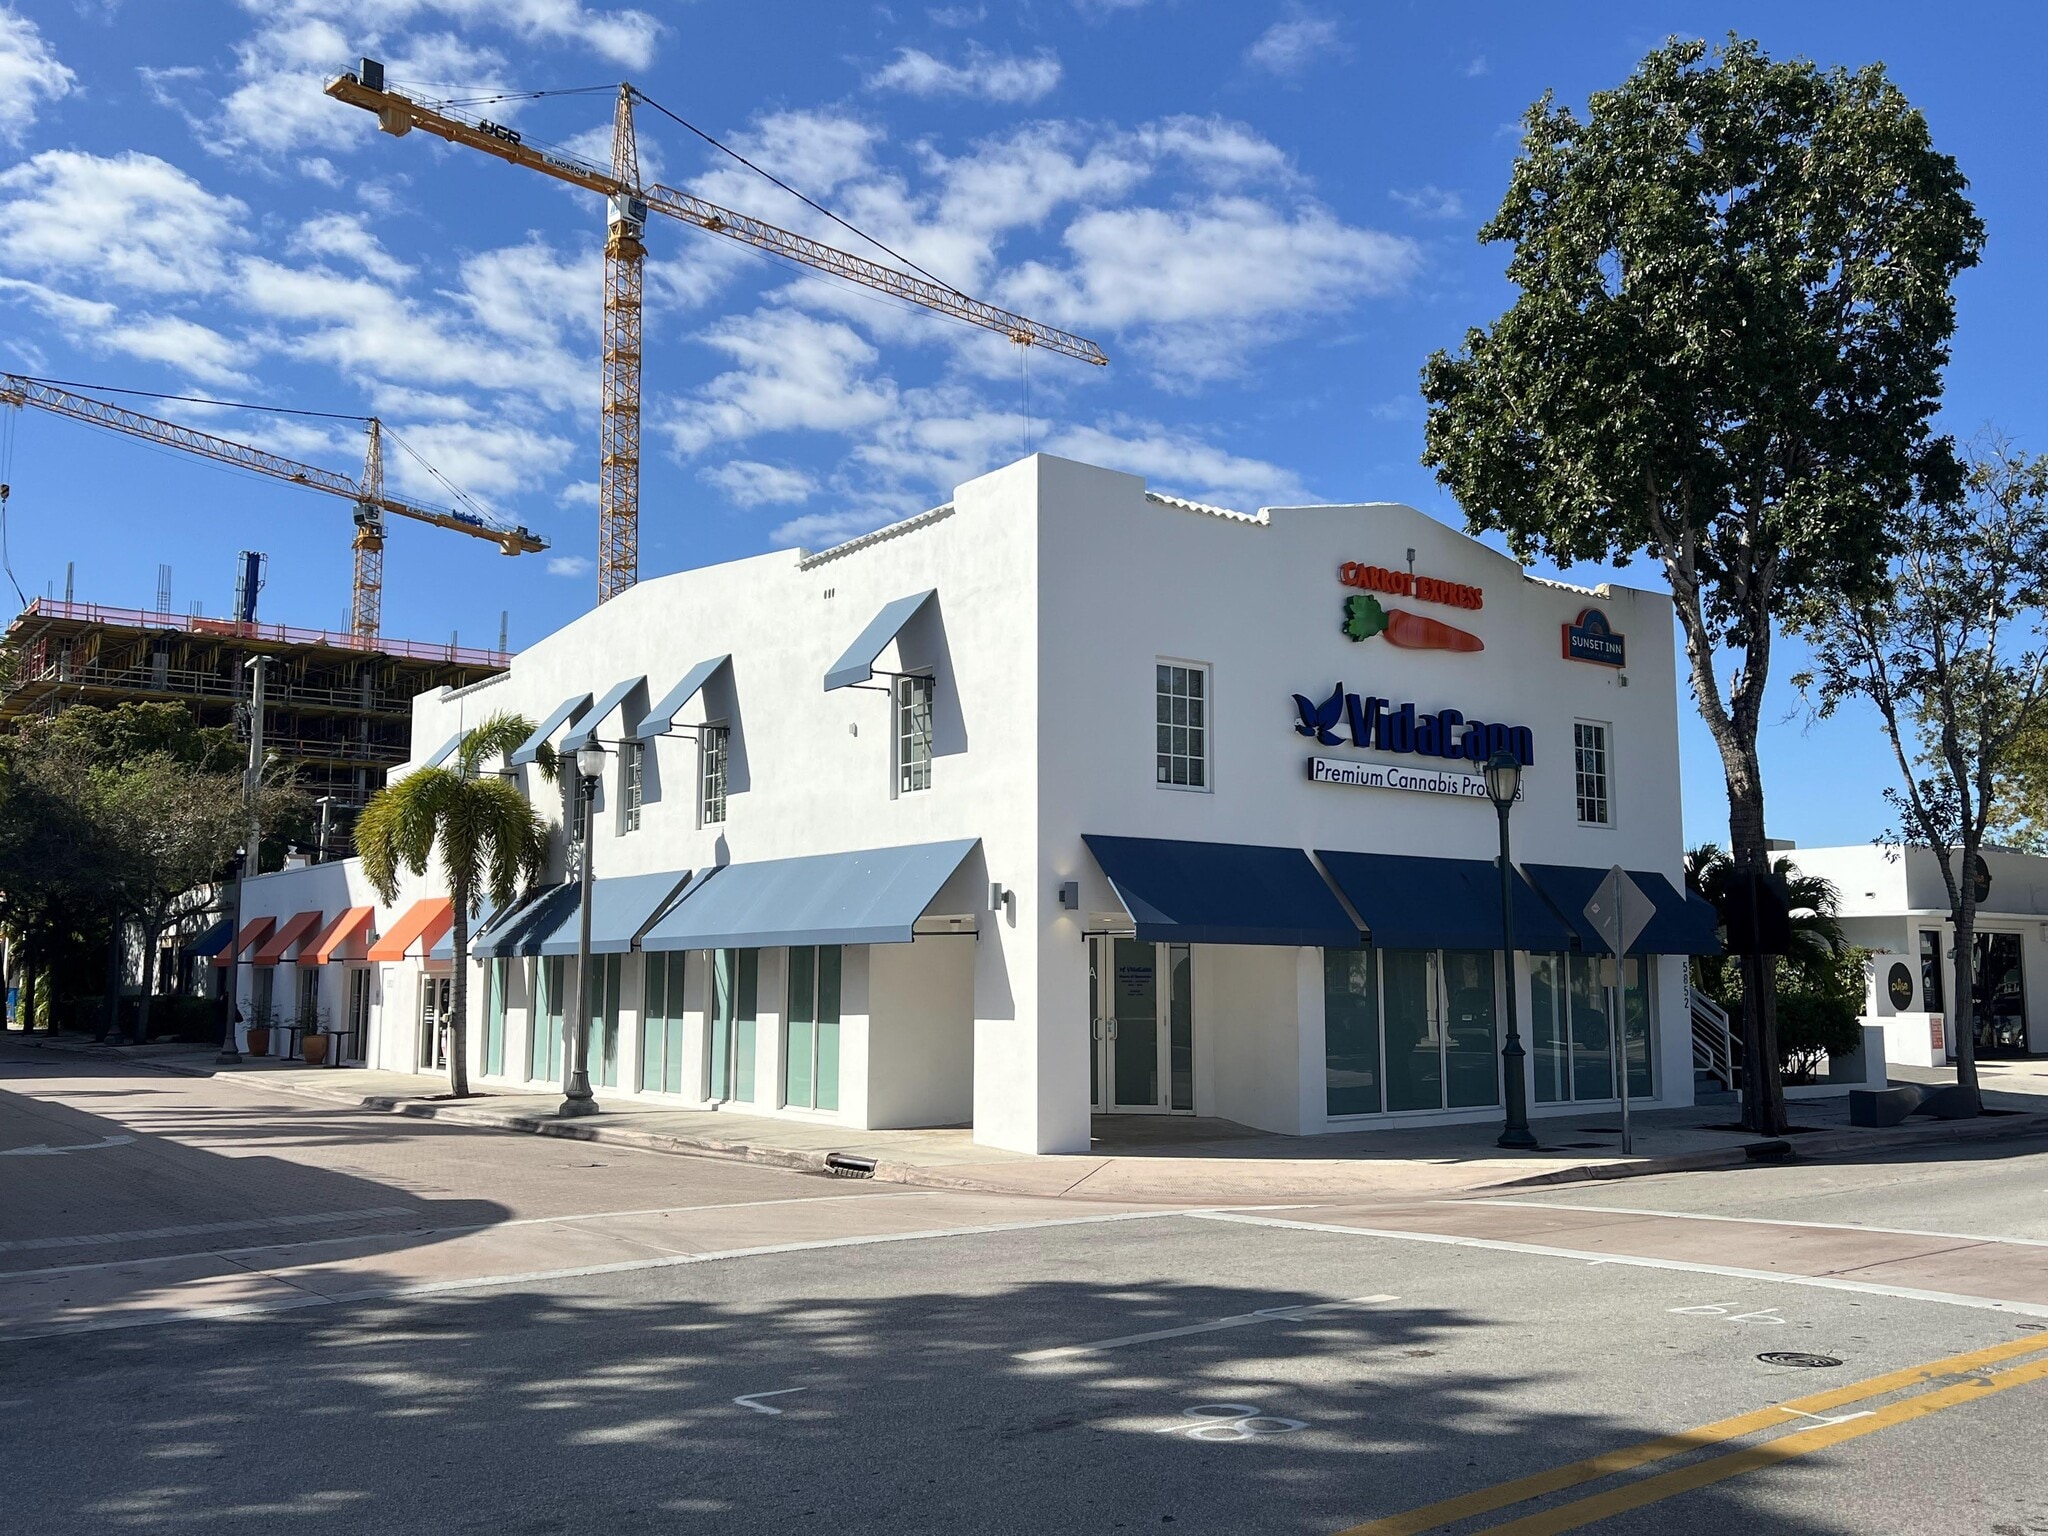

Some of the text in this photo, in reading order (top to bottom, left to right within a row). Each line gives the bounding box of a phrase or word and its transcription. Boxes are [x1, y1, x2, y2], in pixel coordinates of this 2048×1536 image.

[555, 160, 587, 176] MORROW
[1339, 561, 1483, 610] CARROT EXPRESS
[1571, 635, 1604, 651] SUNSET
[1605, 642, 1622, 655] INN
[1345, 692, 1534, 766] VidaCann
[1315, 760, 1522, 800] Premium Cannabis Pros
[1682, 961, 1690, 1009] 5852
